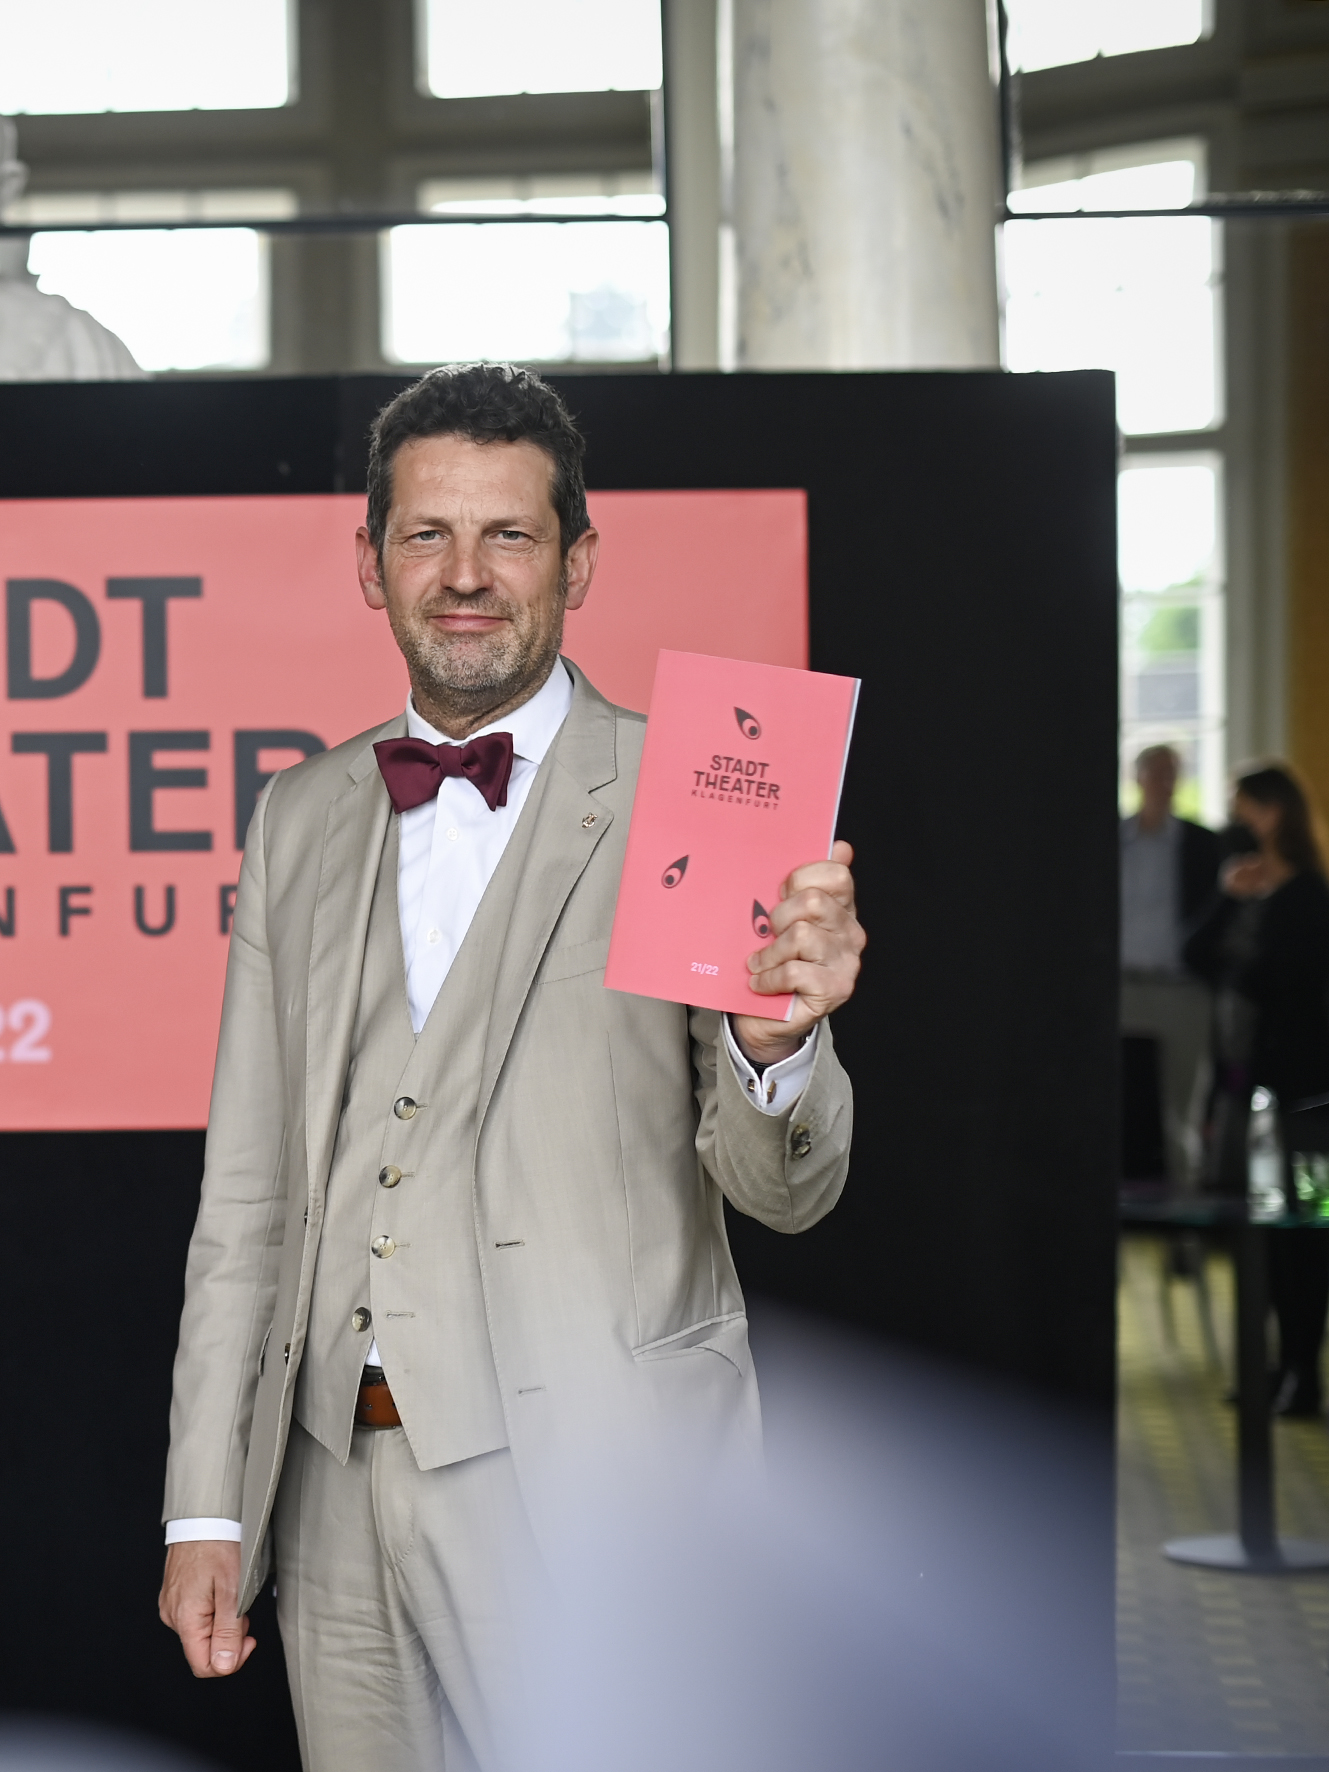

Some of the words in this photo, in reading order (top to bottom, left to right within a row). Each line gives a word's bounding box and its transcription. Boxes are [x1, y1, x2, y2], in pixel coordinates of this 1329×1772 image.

[710, 754, 770, 779] STADT
[693, 770, 780, 801] THEATER
[691, 789, 779, 811] KLAGENFURT
[690, 961, 719, 976] 21/22
